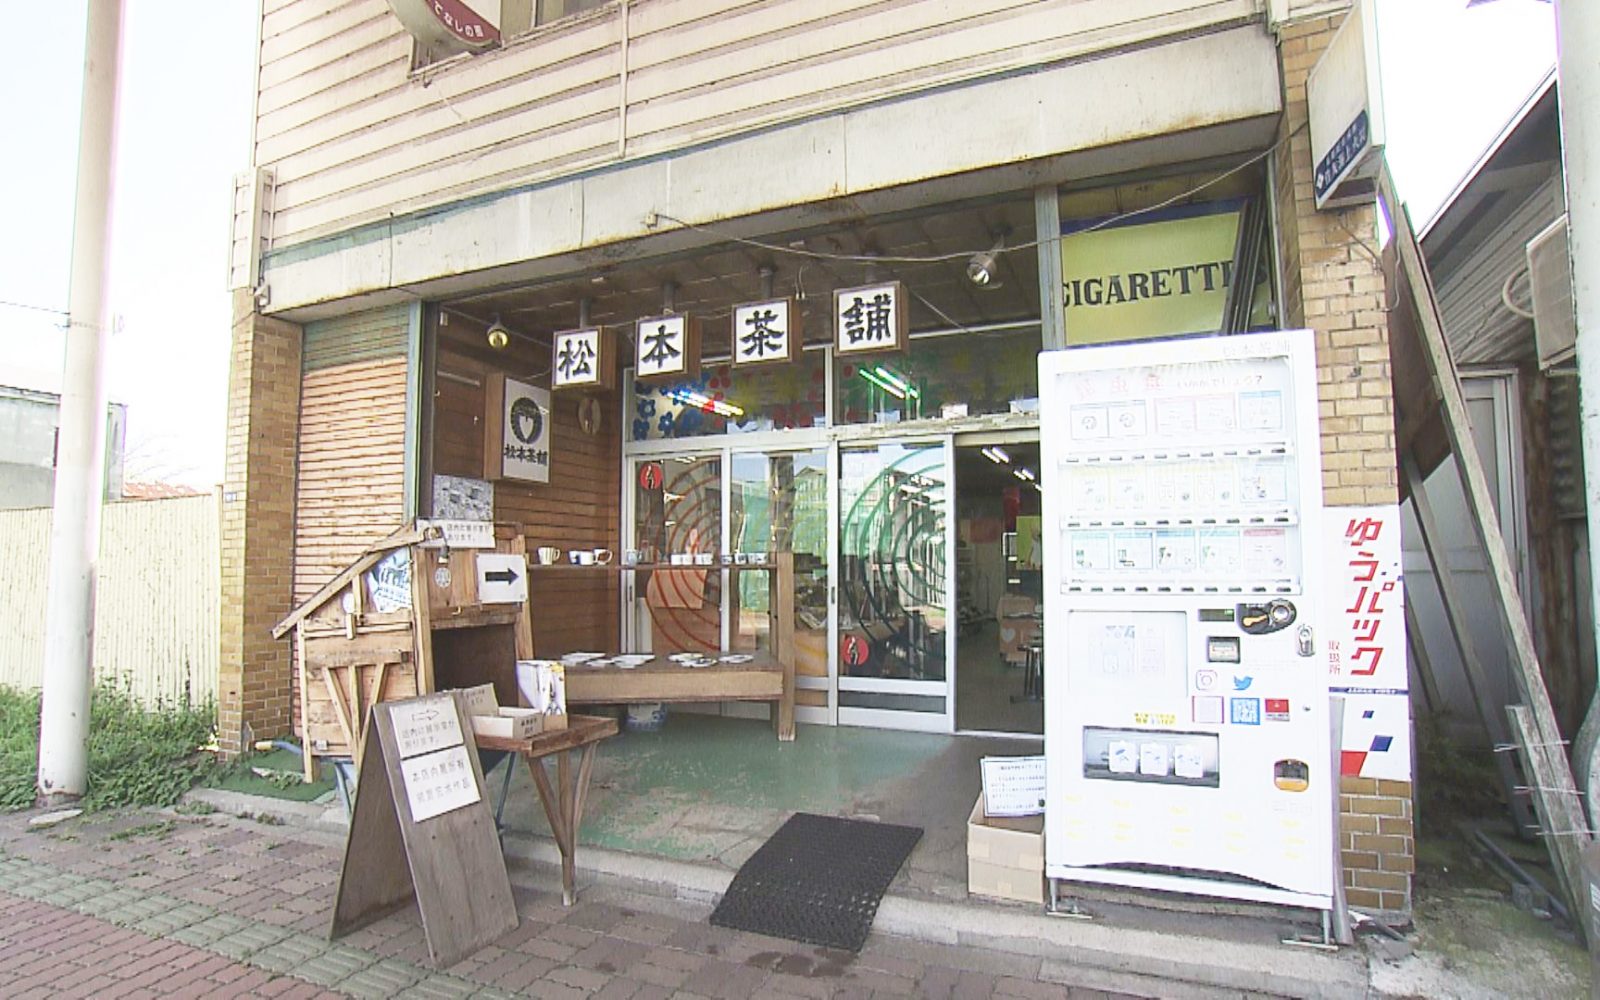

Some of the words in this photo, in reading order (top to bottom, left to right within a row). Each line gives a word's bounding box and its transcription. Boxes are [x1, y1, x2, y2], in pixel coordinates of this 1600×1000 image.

[1345, 517, 1395, 676] ゆうパック
